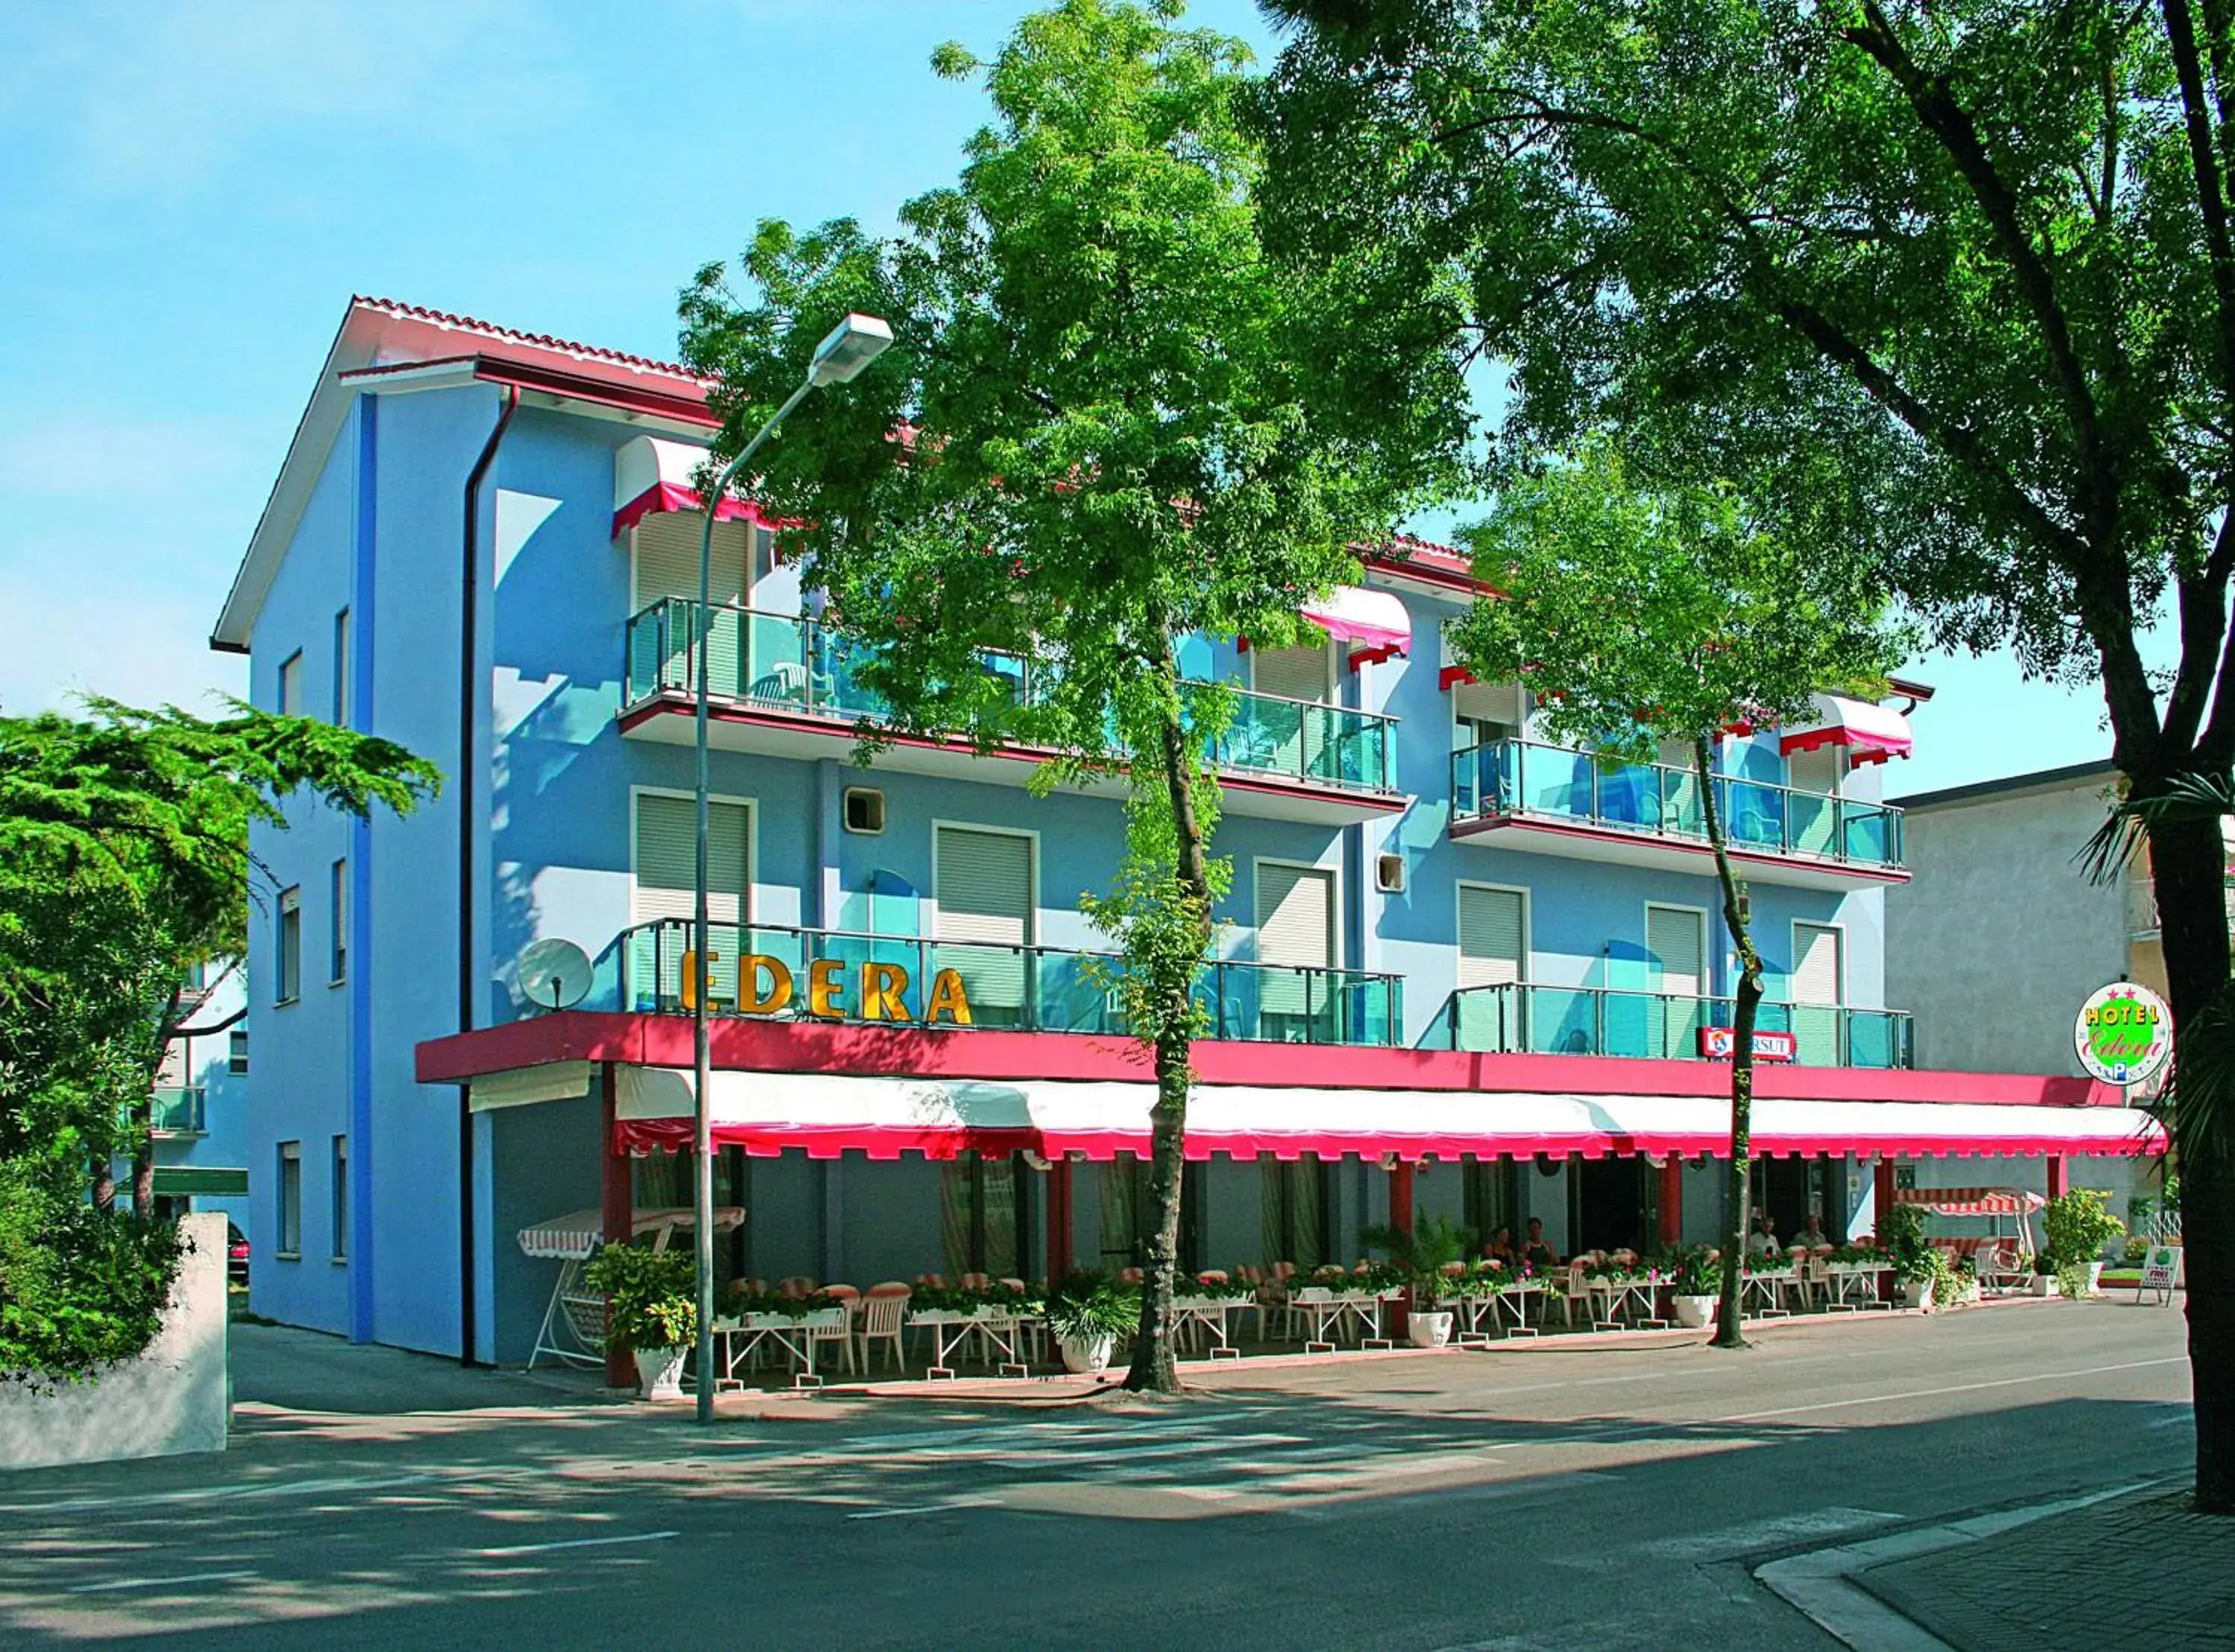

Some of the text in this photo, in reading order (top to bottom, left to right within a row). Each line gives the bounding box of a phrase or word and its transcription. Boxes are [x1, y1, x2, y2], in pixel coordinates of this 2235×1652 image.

[681, 950, 972, 1025] EDERA
[2085, 1004, 2159, 1026] HOTEL
[1751, 1038, 1787, 1052] RSUT
